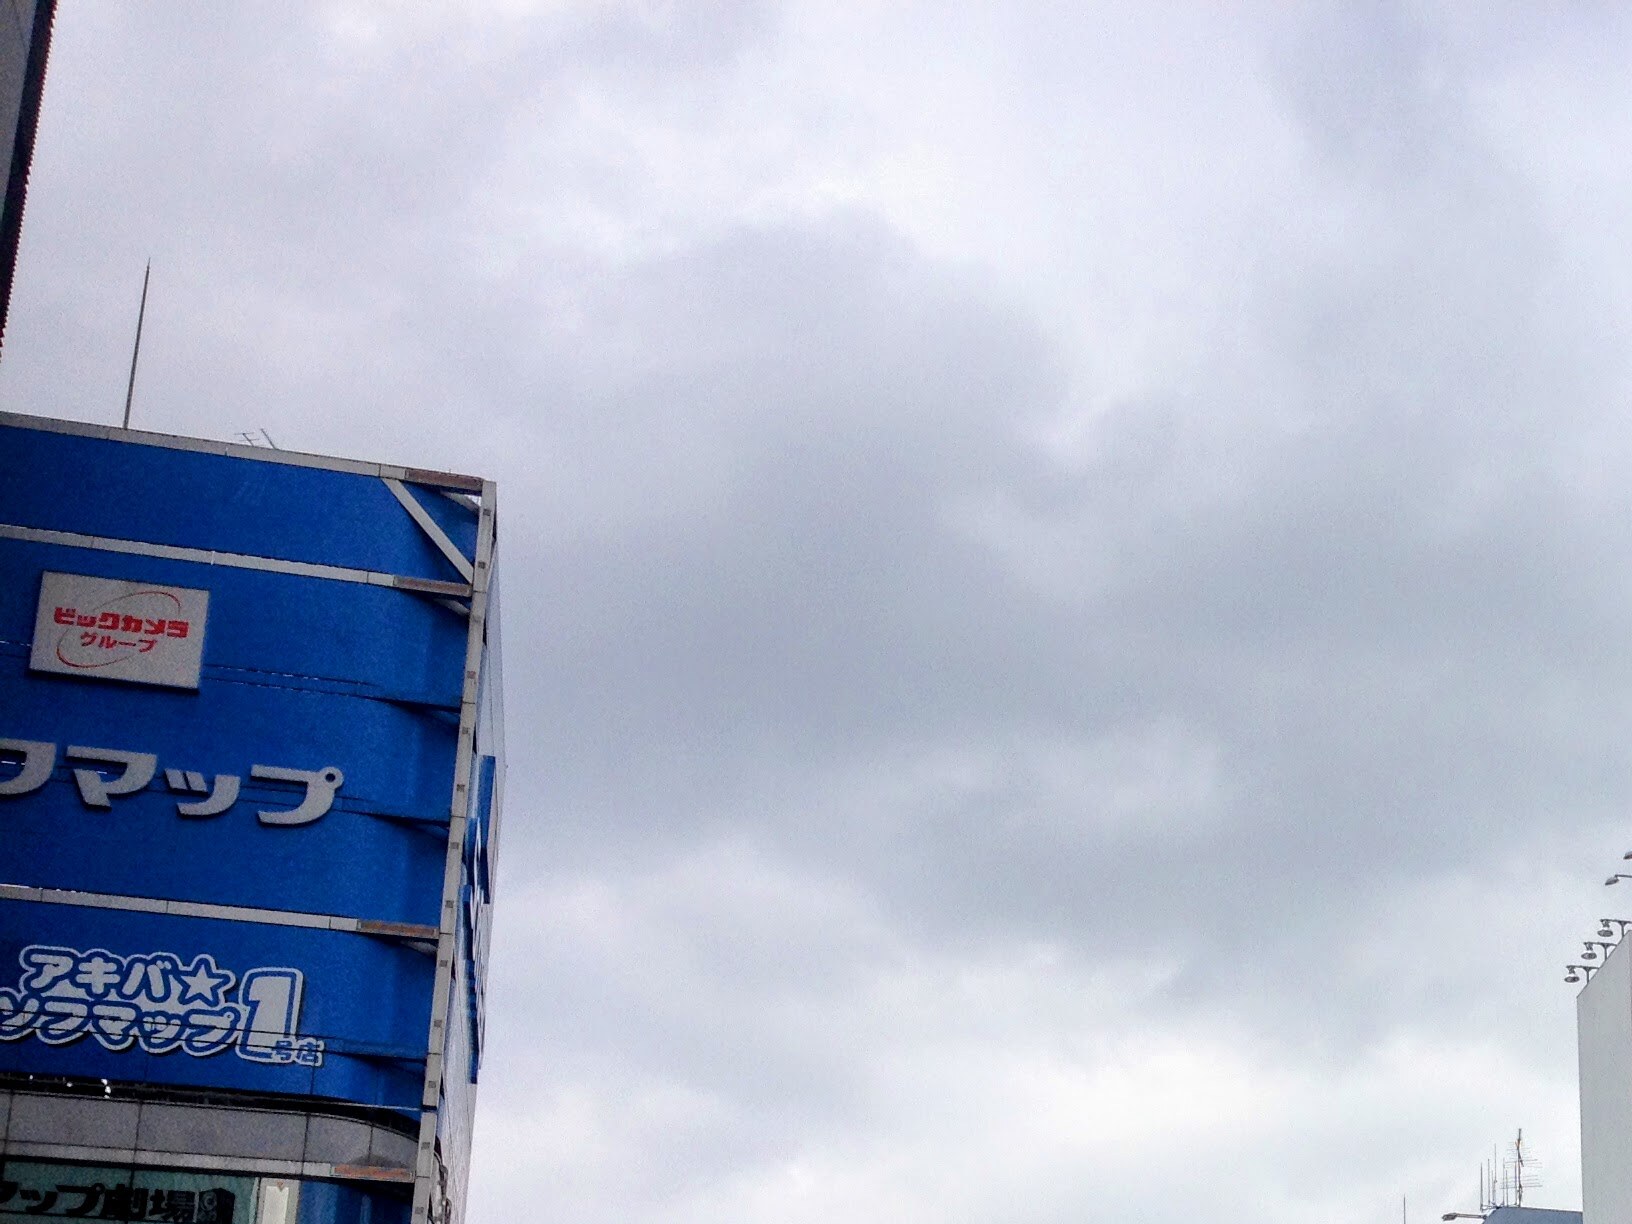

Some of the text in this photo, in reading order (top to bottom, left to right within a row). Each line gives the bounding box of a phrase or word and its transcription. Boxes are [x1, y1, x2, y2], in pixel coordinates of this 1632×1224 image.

[54, 606, 189, 639] ビックカメラ
[80, 630, 158, 654] グループ
